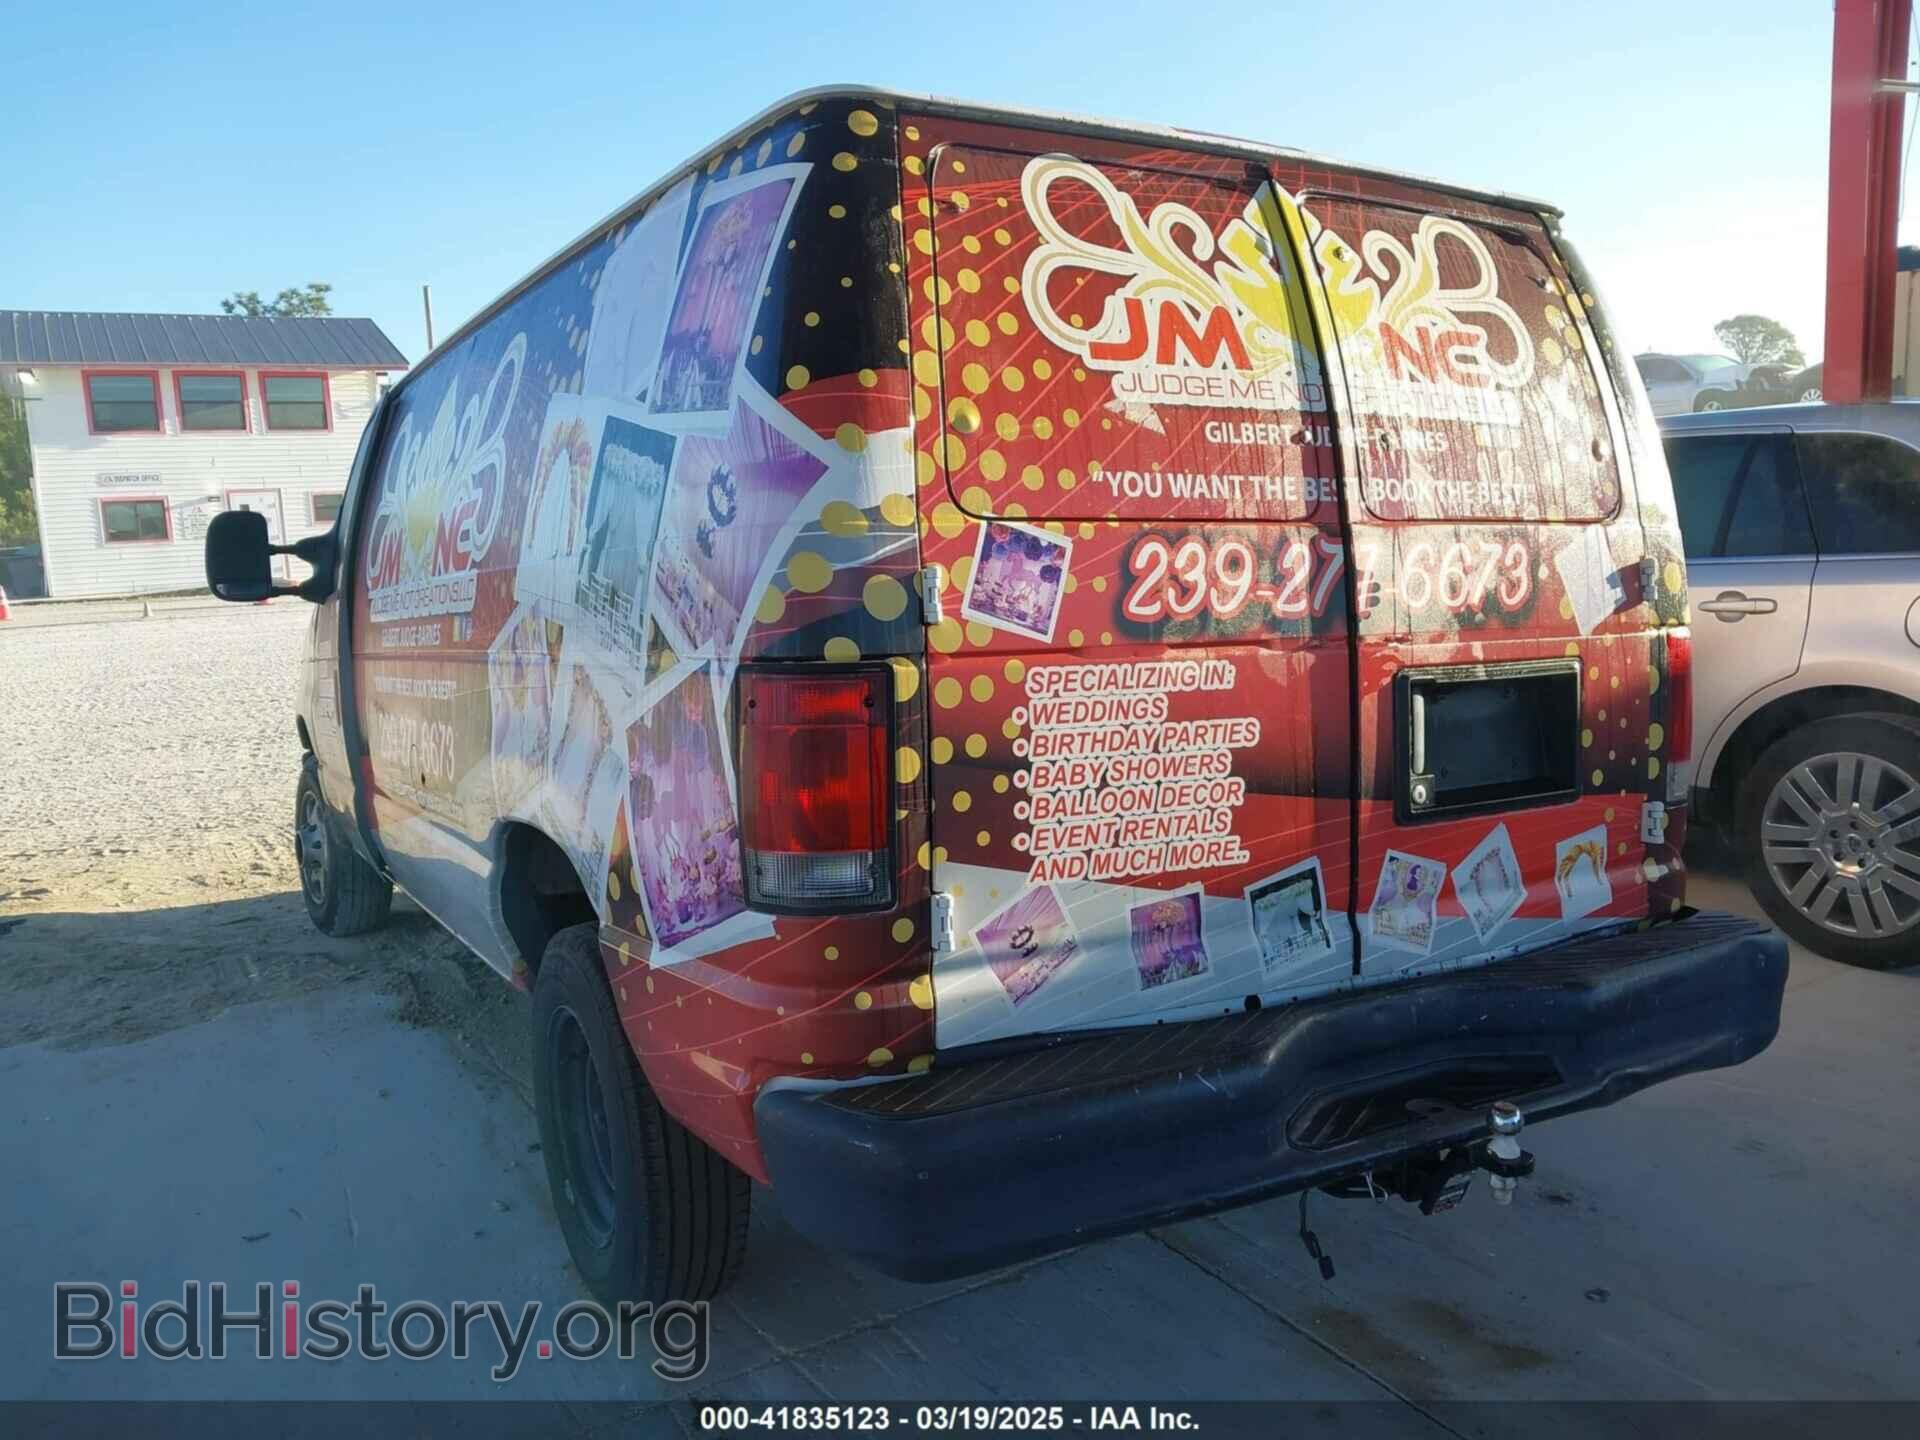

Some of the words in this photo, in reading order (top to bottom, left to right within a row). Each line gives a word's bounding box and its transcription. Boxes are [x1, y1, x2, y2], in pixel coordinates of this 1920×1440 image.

[1089, 298, 1252, 369] JM
[1120, 372, 1225, 398] JUDGE
[1229, 379, 1274, 401] ME
[1281, 382, 1341, 402] NO
[1204, 420, 1293, 446] GILBERT
[1167, 472, 1246, 499] WANT
[1247, 475, 1298, 500] THE
[1374, 477, 1433, 502] BOOK
[1029, 664, 1197, 693] SPECIALIZING
[1203, 662, 1233, 687] IN:
[1032, 696, 1165, 725] WEDDINGS
[1032, 728, 1156, 757] BIRTHDAY
[1162, 721, 1258, 748] PARTIES
[1033, 761, 1103, 789] BABY
[1110, 753, 1230, 783] SHOWERS
[1033, 788, 1154, 820] BALLOON
[1160, 780, 1242, 808] DECOR
[1034, 820, 1117, 850] EVENT
[1123, 811, 1229, 842] RENTALS
[1030, 856, 1084, 882] AND
[1092, 847, 1168, 875] MUCH
